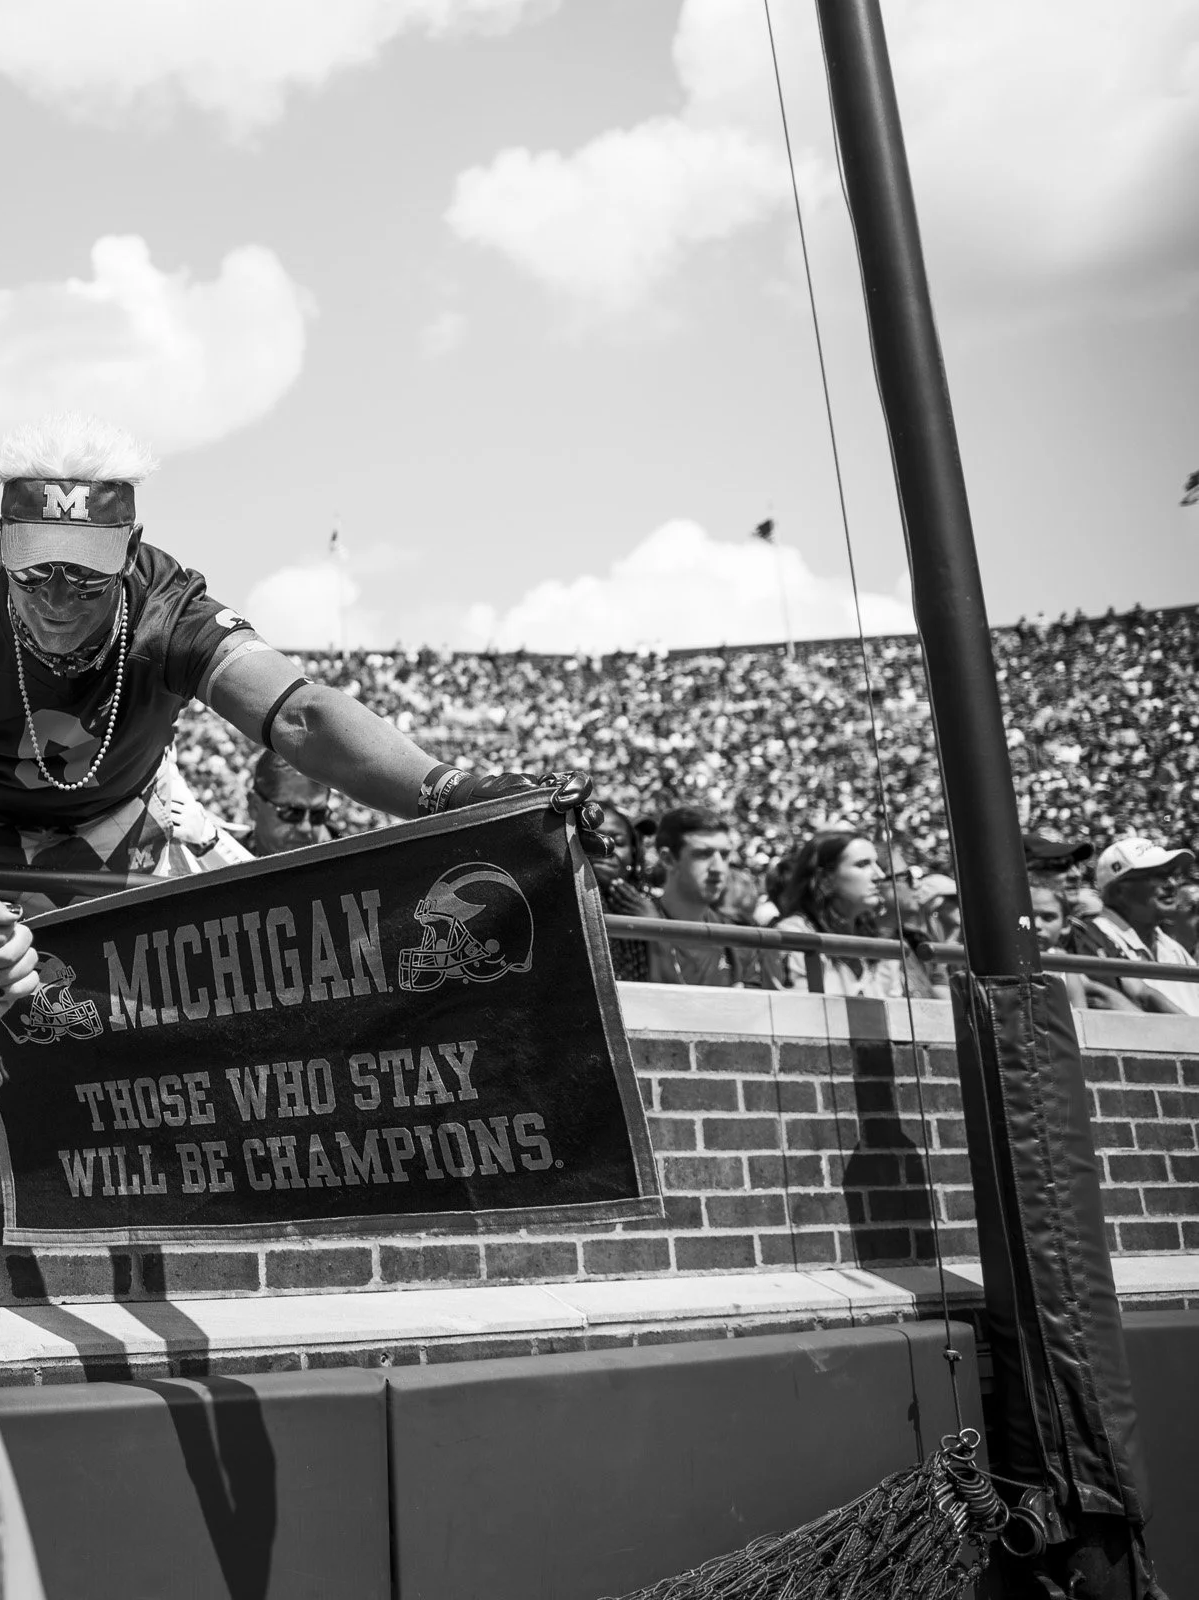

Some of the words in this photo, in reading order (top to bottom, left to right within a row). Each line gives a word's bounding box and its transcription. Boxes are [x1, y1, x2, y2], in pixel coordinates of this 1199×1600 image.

[42, 484, 90, 519] M
[128, 844, 156, 870] M
[102, 889, 385, 1030] MICHIGAN
[75, 1067, 216, 1132] THOSE
[225, 1057, 338, 1122] WHO
[349, 1039, 480, 1112] STAY
[57, 1143, 168, 1198] WILL
[180, 1141, 235, 1195] BE
